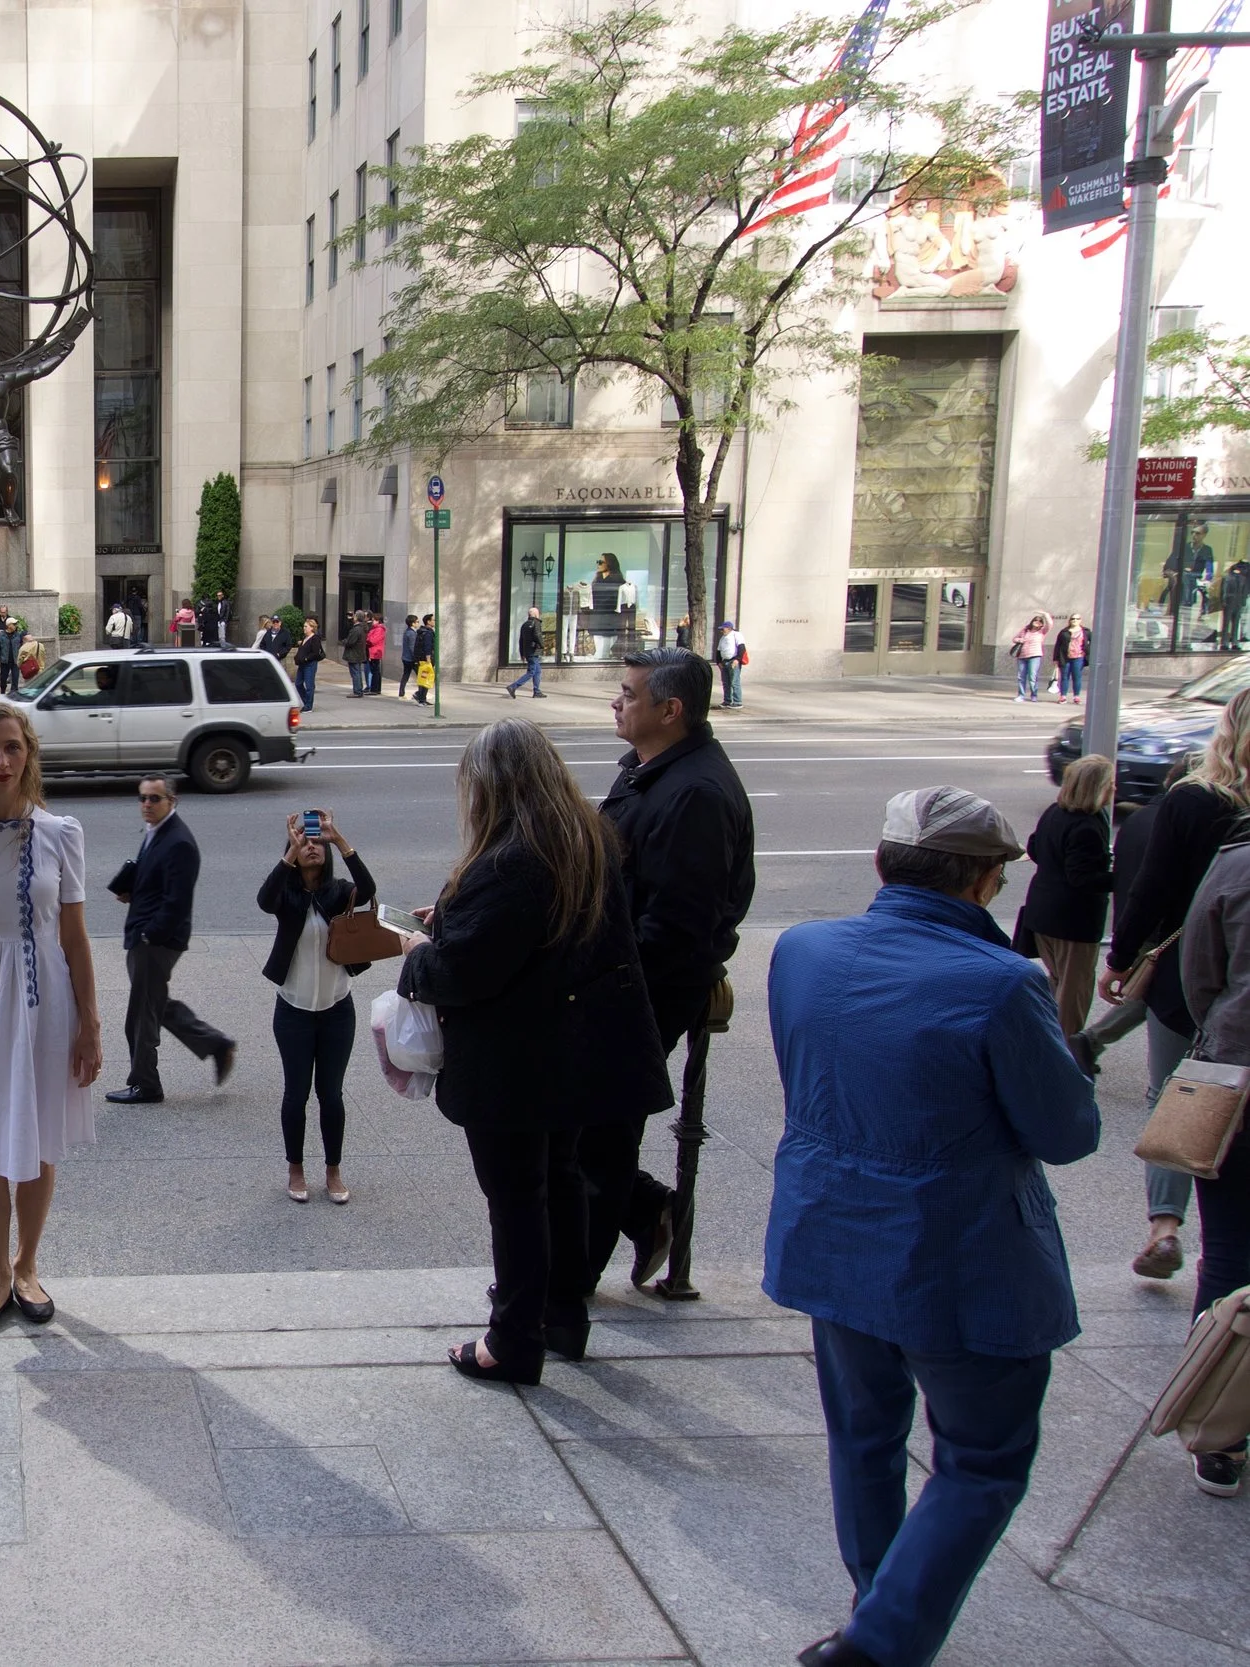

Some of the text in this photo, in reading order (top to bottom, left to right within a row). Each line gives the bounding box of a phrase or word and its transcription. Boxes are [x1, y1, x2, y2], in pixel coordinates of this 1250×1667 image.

[1049, 43, 1073, 67] TO
[1047, 51, 1114, 91] IN REAL
[1045, 75, 1110, 115] ESTATE.
[1068, 172, 1120, 195] CUSHMAN &
[1068, 183, 1121, 206] WAKEFIELD
[1145, 461, 1192, 470] STANDING
[555, 486, 677, 502] FAÇONNABLE
